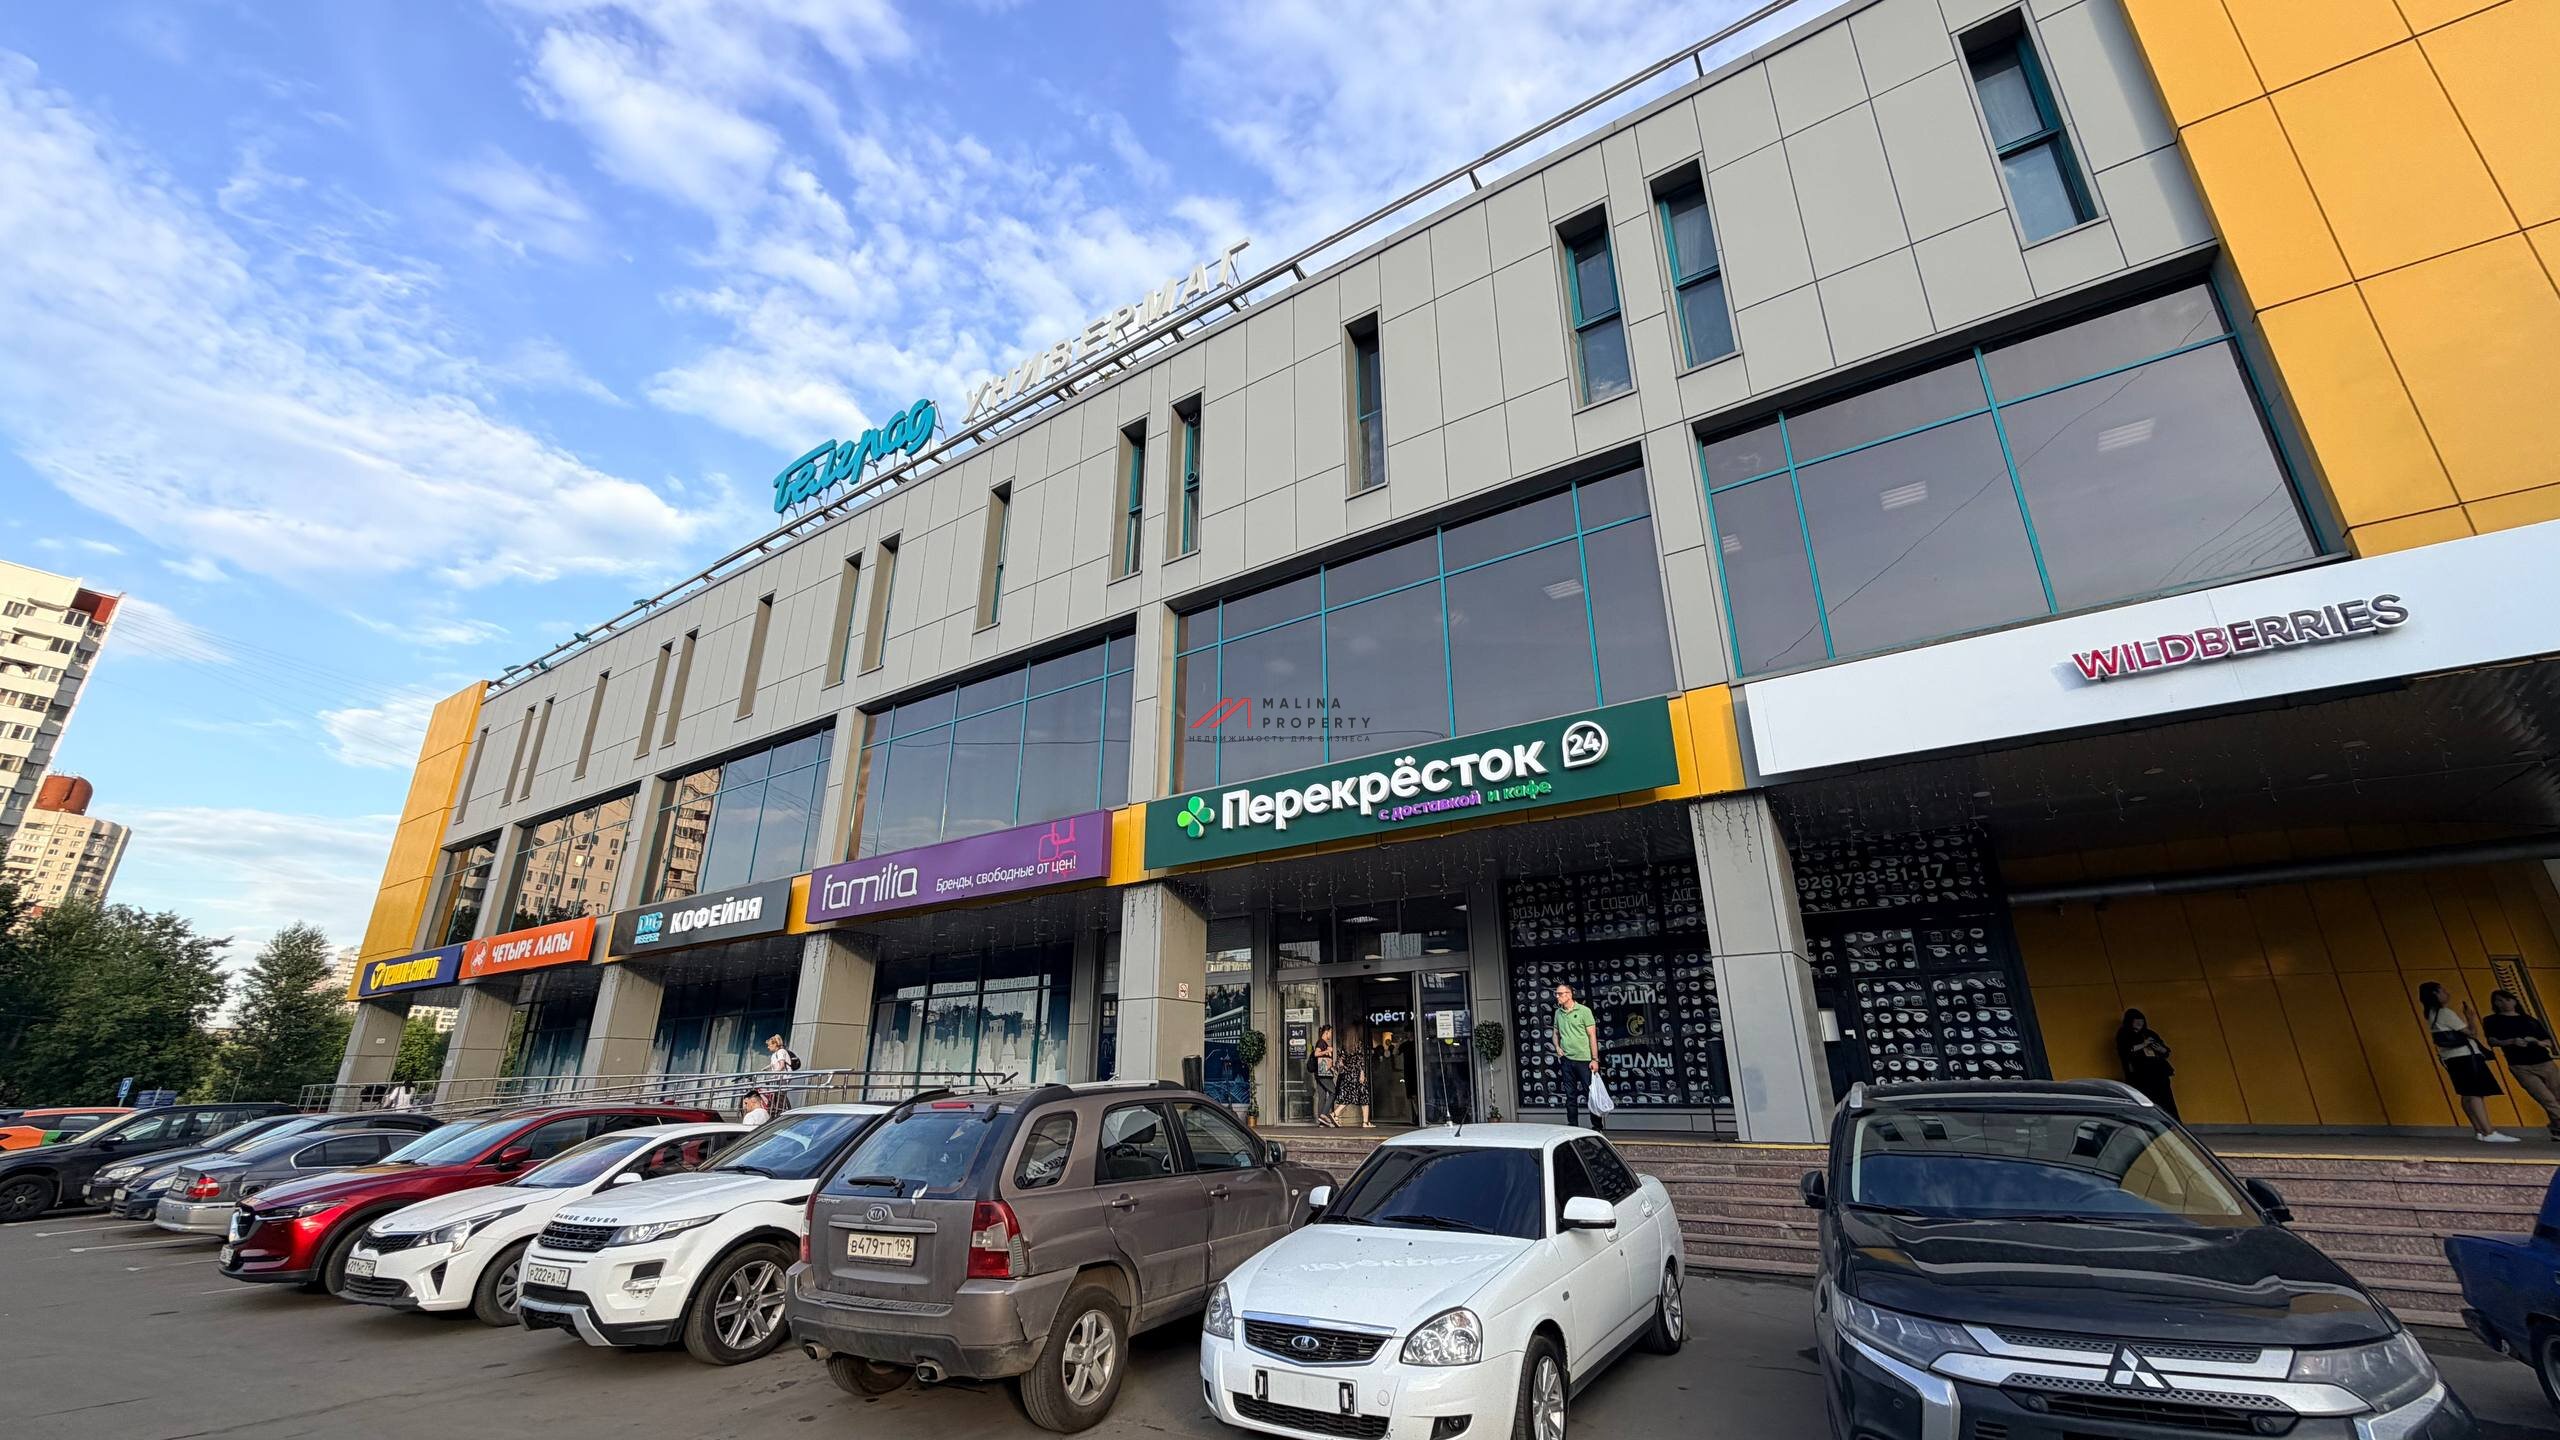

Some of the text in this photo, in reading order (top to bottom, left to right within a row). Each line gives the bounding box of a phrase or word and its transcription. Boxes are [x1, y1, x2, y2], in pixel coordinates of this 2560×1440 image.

[961, 236, 1250, 424] УНИВЕРМАГ
[2072, 594, 2409, 680] WILDBERRIES
[1568, 731, 1600, 757] 24
[1221, 740, 1550, 830] Перекрёсток
[1391, 790, 1482, 821] доставкой
[1487, 790, 1500, 802] и
[1503, 780, 1552, 799] кафе
[821, 862, 918, 911] familia
[936, 855, 1077, 894] Бренды, свободные от цен!
[669, 897, 763, 934] КОФЕЙНЯ
[1513, 903, 1564, 919] ВОЗЬМИ
[1600, 891, 1649, 911] СОБОЙ!
[492, 931, 574, 963] ЧЕТЫРЕ ЛАПЫ
[1607, 989, 1656, 1005] СУШИ
[1610, 1052, 1673, 1068] РОЛЛЫ
[555, 1213, 580, 1221] RANGE
[868, 1208, 885, 1220] KIA
